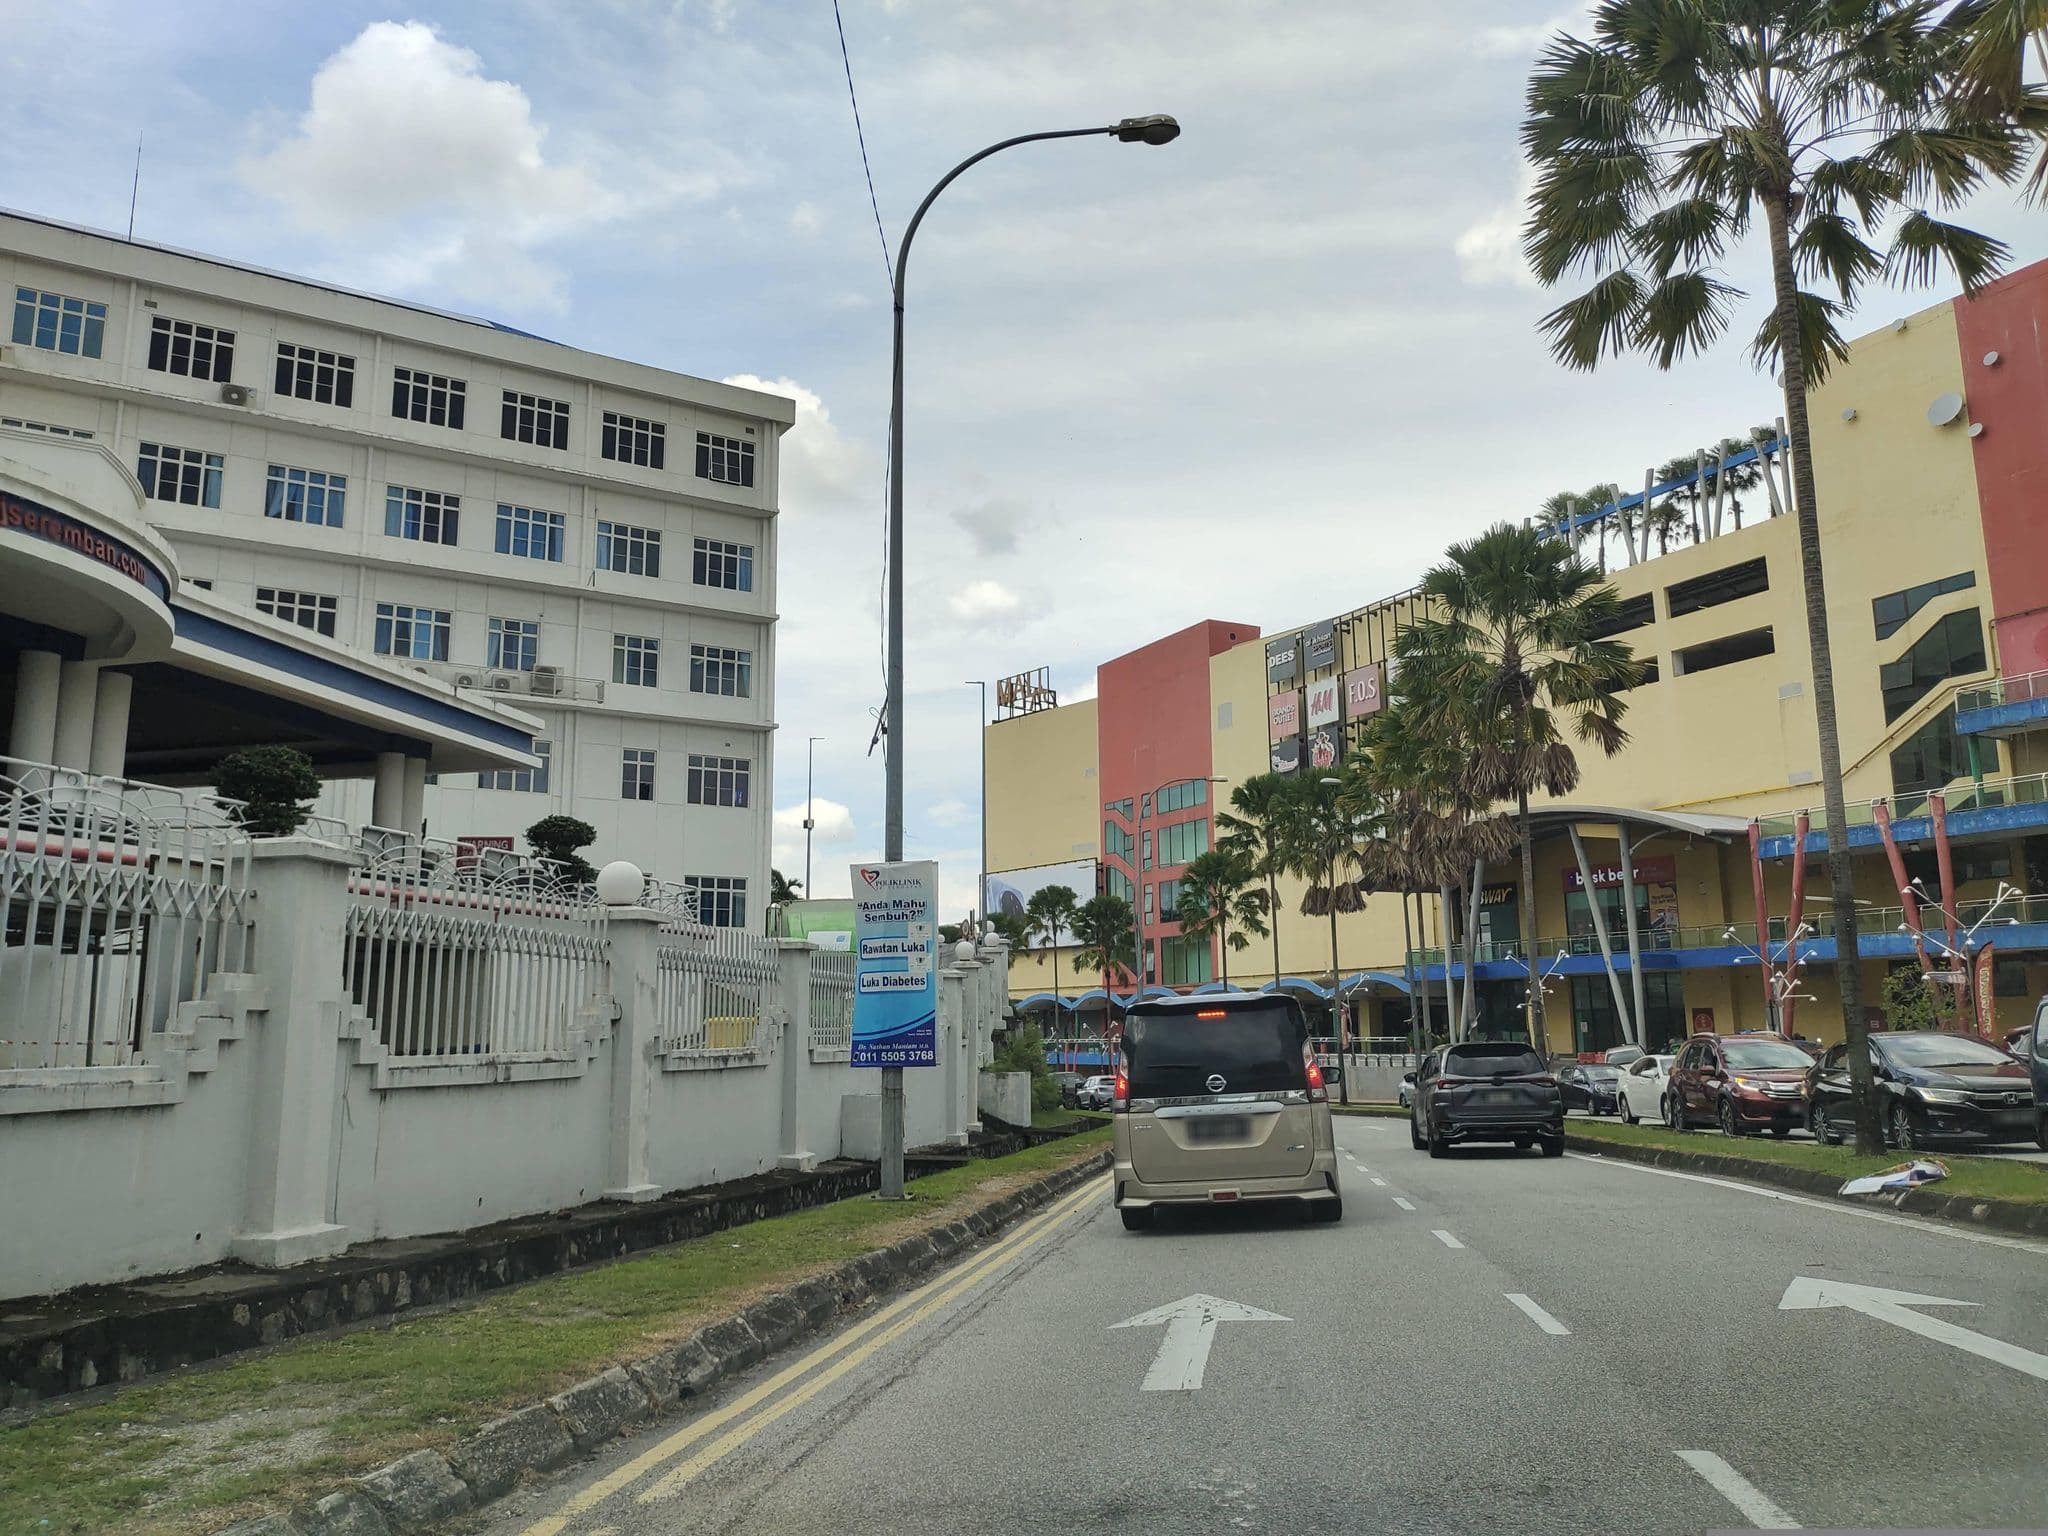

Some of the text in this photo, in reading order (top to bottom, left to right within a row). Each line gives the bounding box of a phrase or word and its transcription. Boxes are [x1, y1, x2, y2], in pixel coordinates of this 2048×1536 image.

[1269, 650, 1295, 667] DEES
[1349, 678, 1376, 704] F.O.S
[1273, 713, 1296, 726] OUTLET
[1575, 869, 1606, 885] bsk
[1608, 867, 1639, 881] ber
[892, 900, 925, 909] Mahu
[862, 941, 925, 955] Rawatan Luka
[861, 976, 926, 988] Luka Diabetes
[860, 1050, 934, 1062] 011 5505 3768
